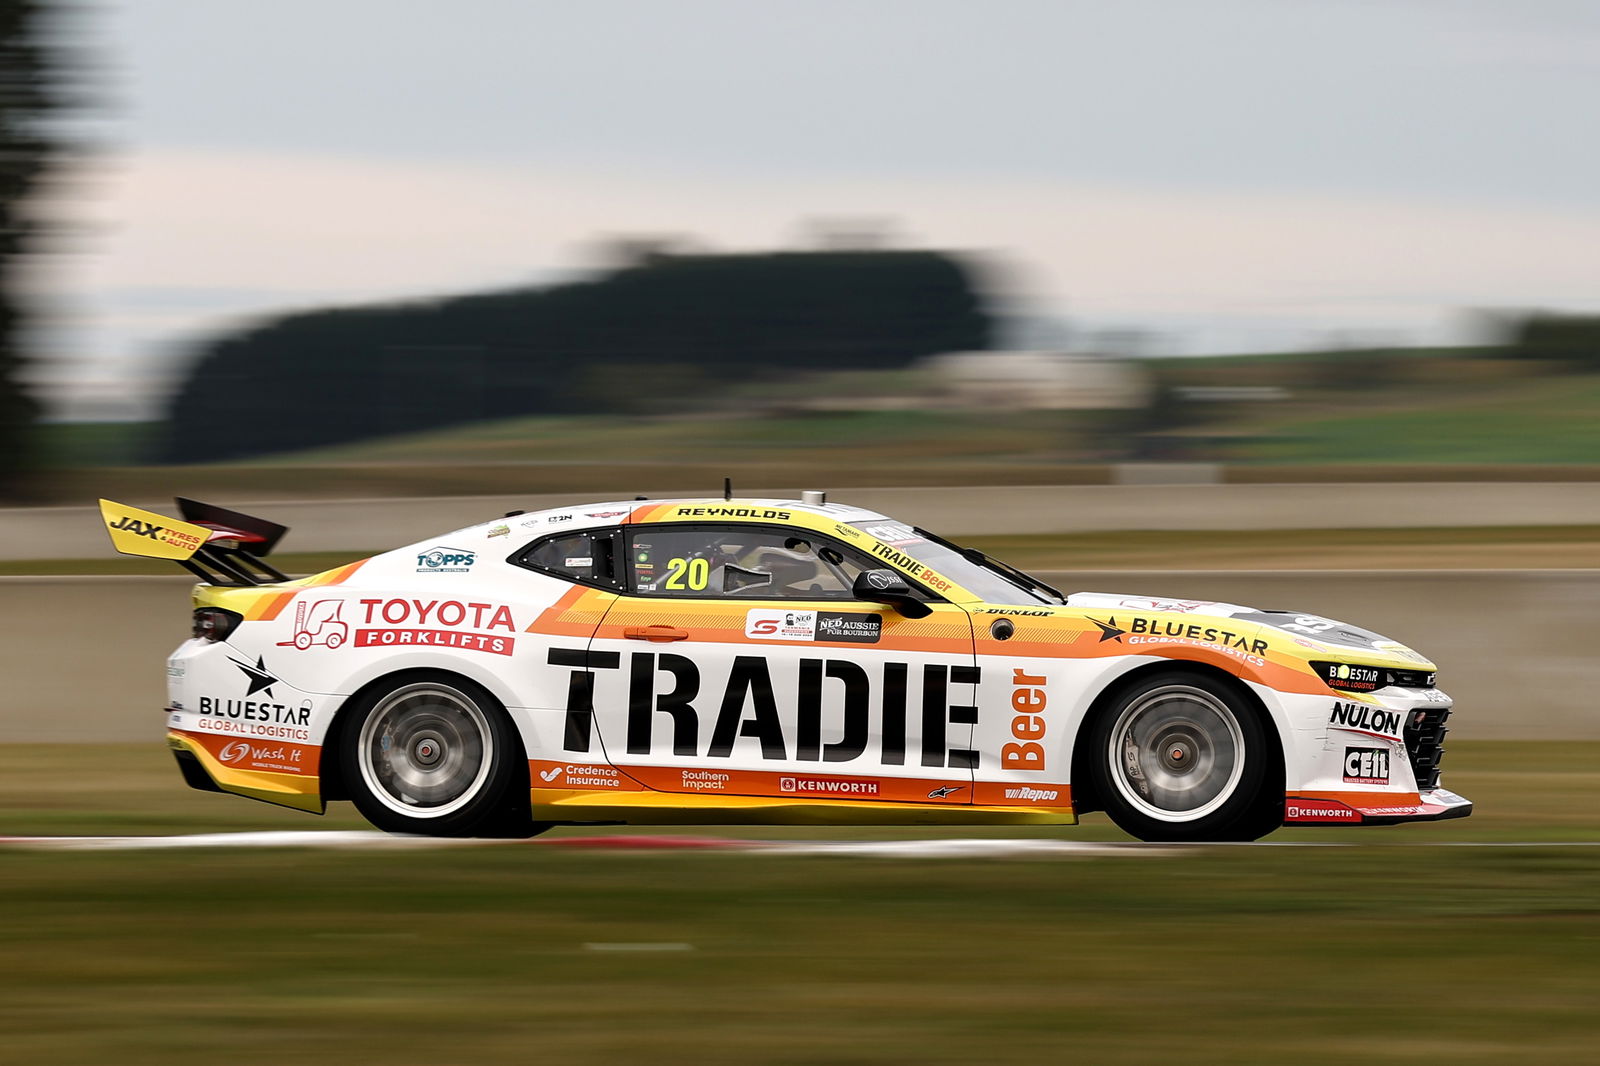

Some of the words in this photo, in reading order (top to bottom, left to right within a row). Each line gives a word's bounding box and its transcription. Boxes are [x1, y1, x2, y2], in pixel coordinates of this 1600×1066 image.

[677, 508, 791, 520] REYNOLDS
[110, 517, 165, 540] JAX
[163, 528, 201, 544] TYRES
[166, 538, 197, 551] AUTO
[417, 551, 475, 567] TOPPS
[871, 541, 924, 576] TRADIE
[920, 569, 952, 592] Beer
[665, 558, 709, 591] 20
[360, 598, 516, 632] TOYOTA
[986, 608, 1055, 617] DUNLOP
[819, 618, 843, 630] NED
[842, 621, 879, 631] AUSSIE
[843, 629, 878, 637] BOURBON
[1131, 617, 1268, 657] BLUESTAR
[366, 631, 505, 652] FORKLIFTS
[1129, 635, 1188, 645] GLOBAL
[1191, 640, 1265, 667] LOGISTICS
[1329, 665, 1378, 682] BESTAR
[1328, 679, 1350, 687] GLOBAL
[1350, 681, 1376, 690] LOGISTICS
[200, 696, 311, 726] BLUESTAR
[547, 647, 982, 769] TRADIE
[1001, 668, 1047, 771] Beer
[1329, 701, 1401, 735] NULON
[198, 718, 246, 733] GLOBAL
[250, 723, 309, 740] LOGISTICS
[251, 746, 285, 760] Wash
[290, 749, 302, 762] It
[565, 765, 618, 777] Credence
[1345, 751, 1389, 778] CEIL
[566, 775, 620, 787] Insurance
[681, 770, 729, 781] Southern
[682, 779, 725, 790] Impact.
[798, 780, 878, 793] KENWORTH
[1020, 787, 1058, 802] Repco
[1299, 808, 1353, 818] KENWORTH
